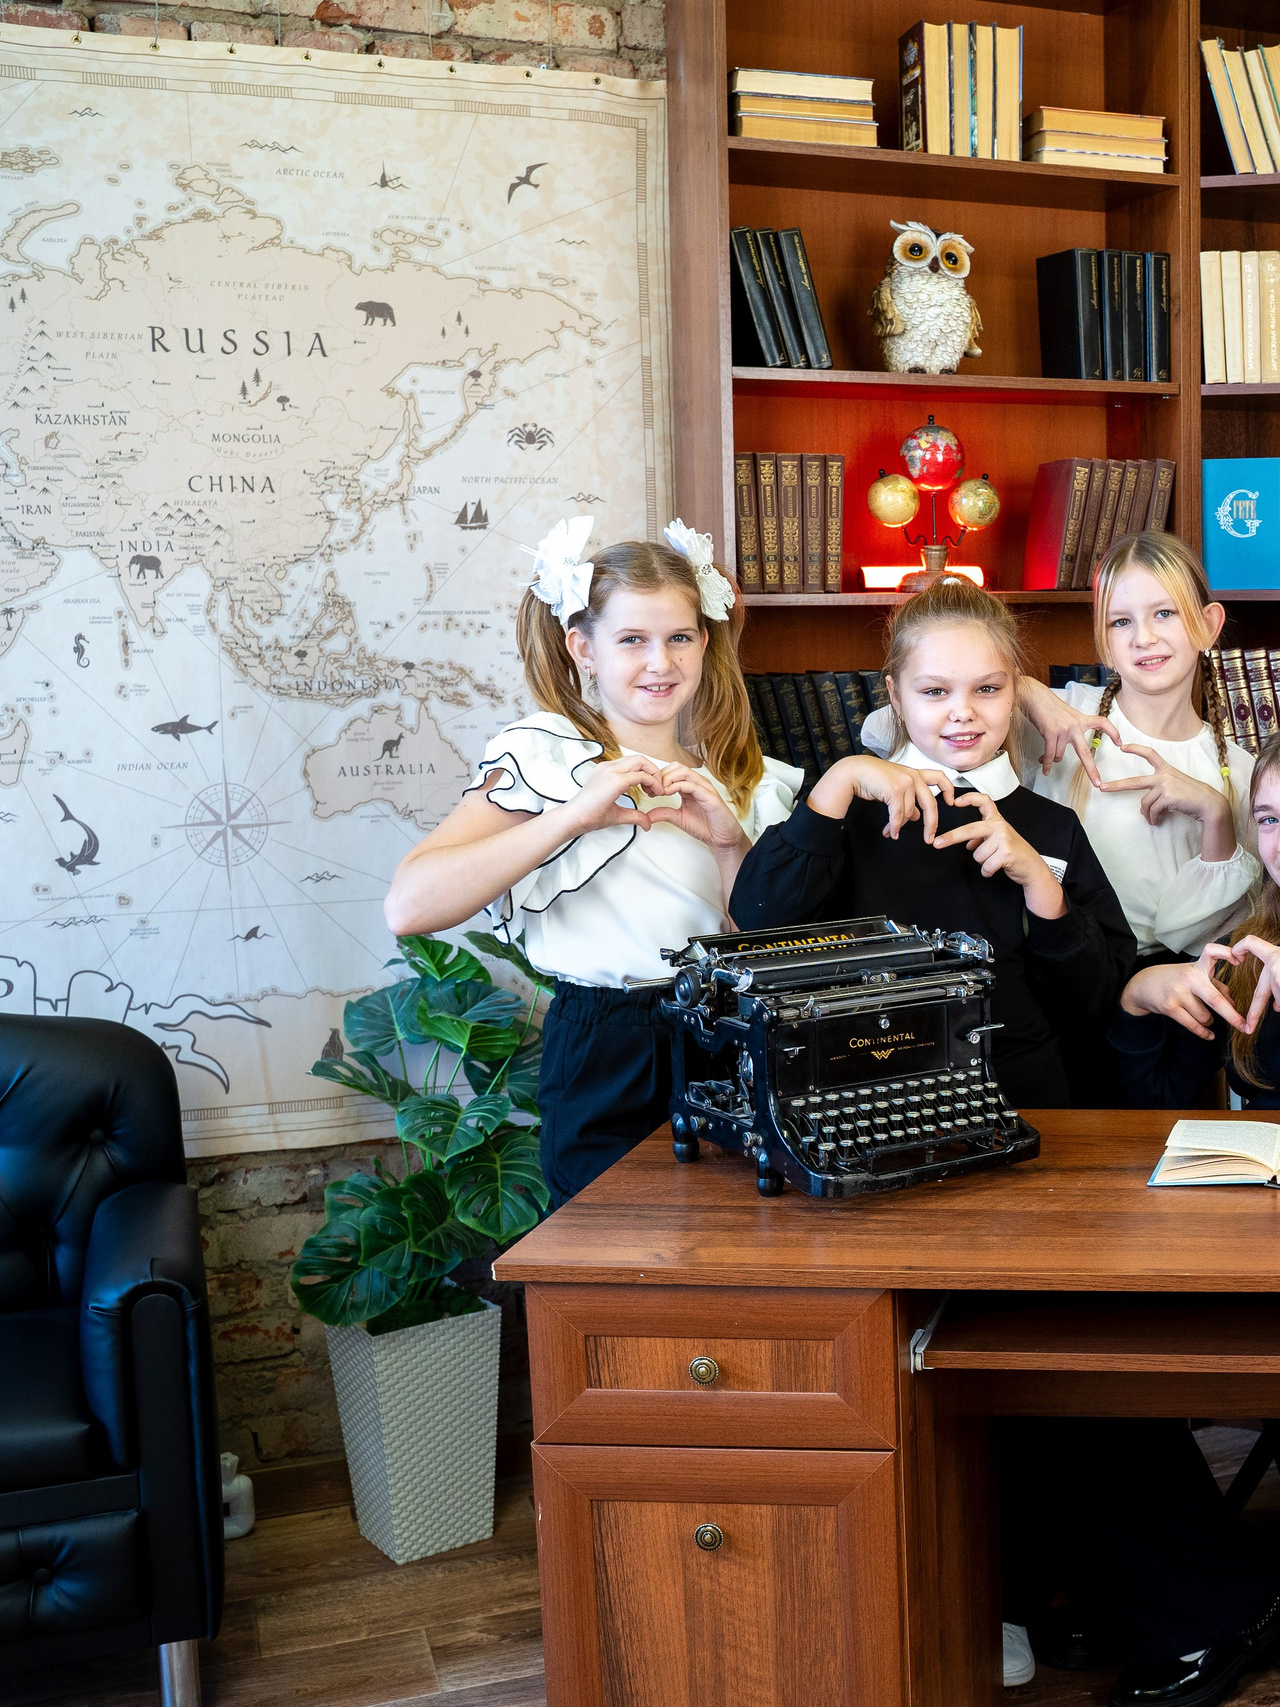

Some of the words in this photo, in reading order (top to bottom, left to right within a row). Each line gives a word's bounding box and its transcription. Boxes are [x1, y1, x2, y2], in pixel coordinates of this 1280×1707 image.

[275, 167, 310, 178] ARCTIC
[313, 170, 345, 180] OCEAN
[210, 280, 258, 289] CENTRAL
[237, 293, 285, 302] PLATEAU
[56, 330, 85, 339] WEST
[89, 332, 144, 340] SIBERIAN
[147, 325, 329, 358] RUSSIA
[85, 352, 118, 360] PLAIN
[34, 413, 128, 426] KAZAKHSTAN
[211, 433, 281, 445] MONGOLIA
[188, 474, 276, 494] CHINA
[461, 476, 492, 484] NORTH
[494, 476, 528, 485] PACIFIC
[529, 476, 559, 485] OCEAN
[413, 486, 441, 496] JAPAN
[20, 504, 52, 515] IRAN
[173, 500, 219, 508] HIMALAYA
[1232, 499, 1257, 520] ГЕТЕ
[119, 539, 175, 553] INDIA
[294, 678, 401, 692] INDONESIA
[116, 763, 152, 771] INDIAN
[156, 762, 189, 771] OCEAN
[337, 763, 436, 778] AUSTRALIA
[849, 1032, 916, 1049] CONTINENTAL
